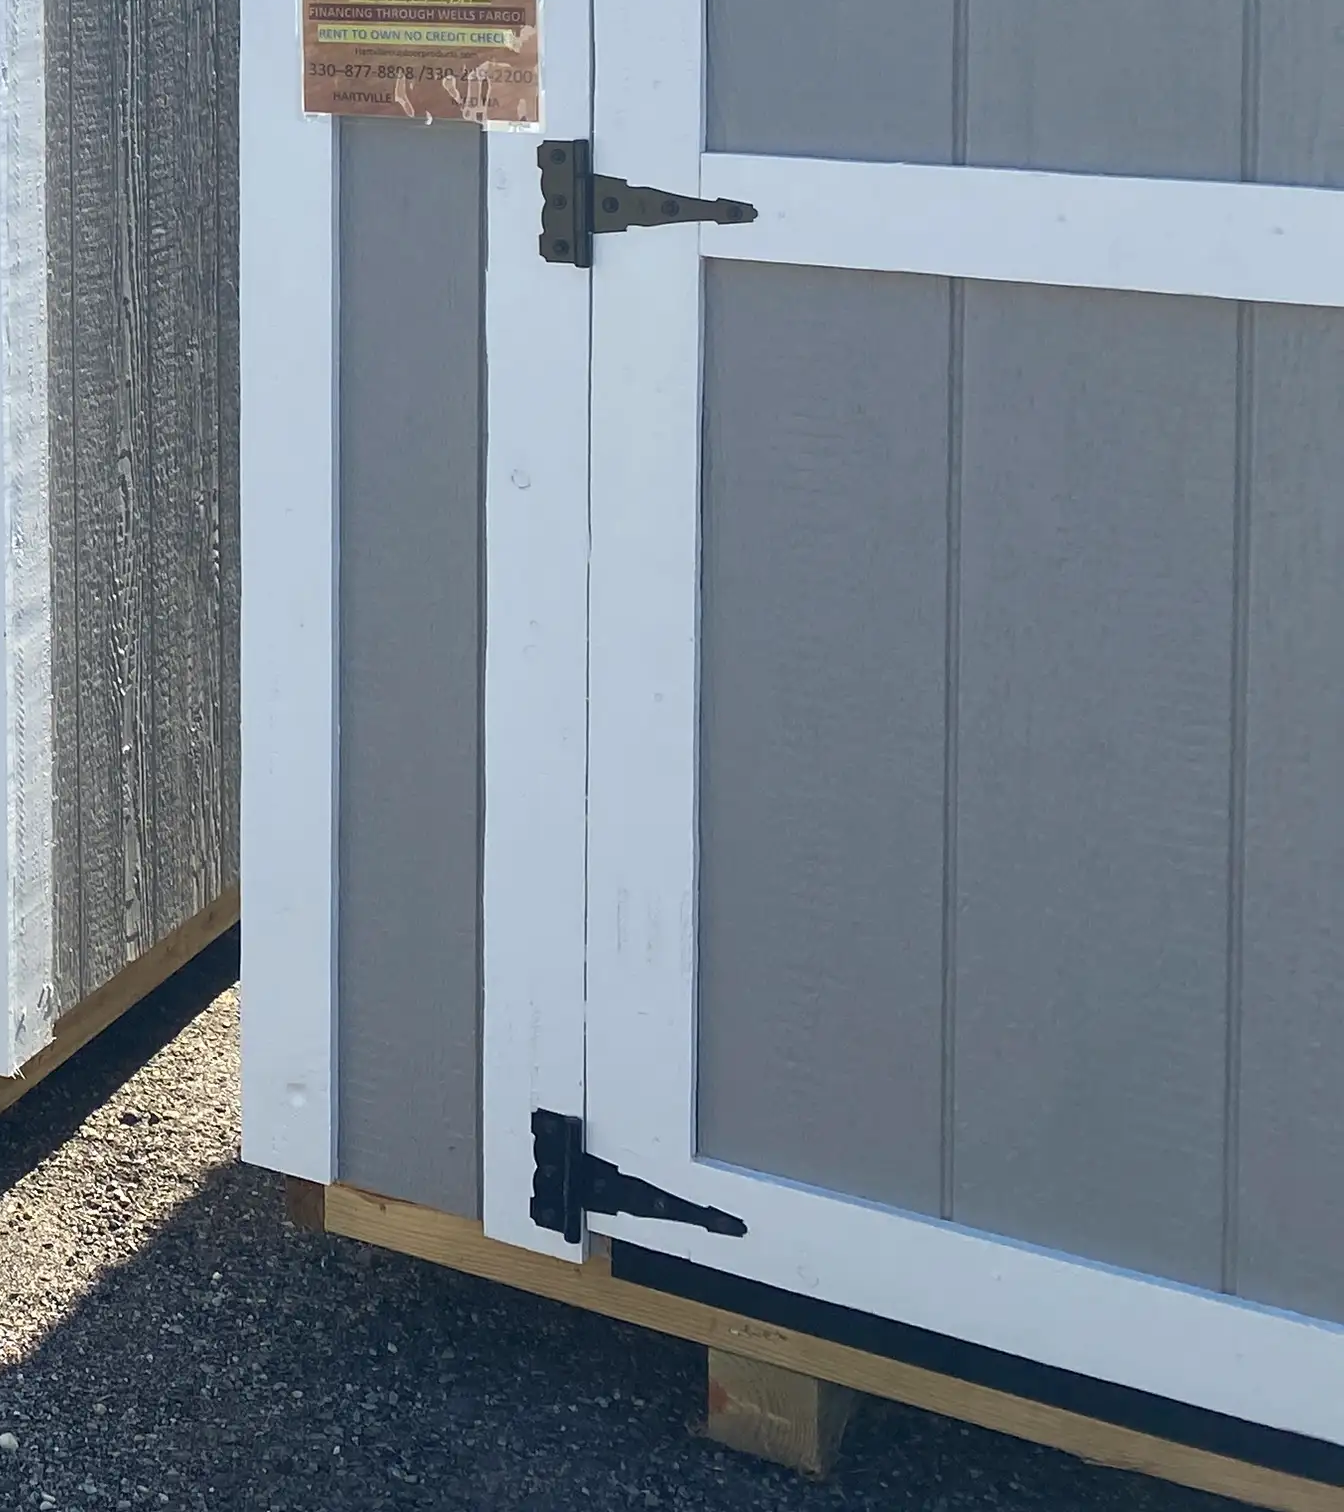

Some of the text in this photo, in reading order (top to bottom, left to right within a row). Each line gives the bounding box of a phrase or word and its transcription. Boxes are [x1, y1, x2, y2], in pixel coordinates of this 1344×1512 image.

[309, 4, 372, 18] FINANCING
[377, 8, 434, 20] THROUGH
[438, 9, 475, 20] WELLS
[319, 29, 348, 40] RENT
[352, 30, 367, 40] TO
[370, 30, 400, 40] OWN
[404, 31, 422, 40] NO
[426, 31, 466, 42] CREDIT
[333, 91, 392, 103] HARTVILLE
